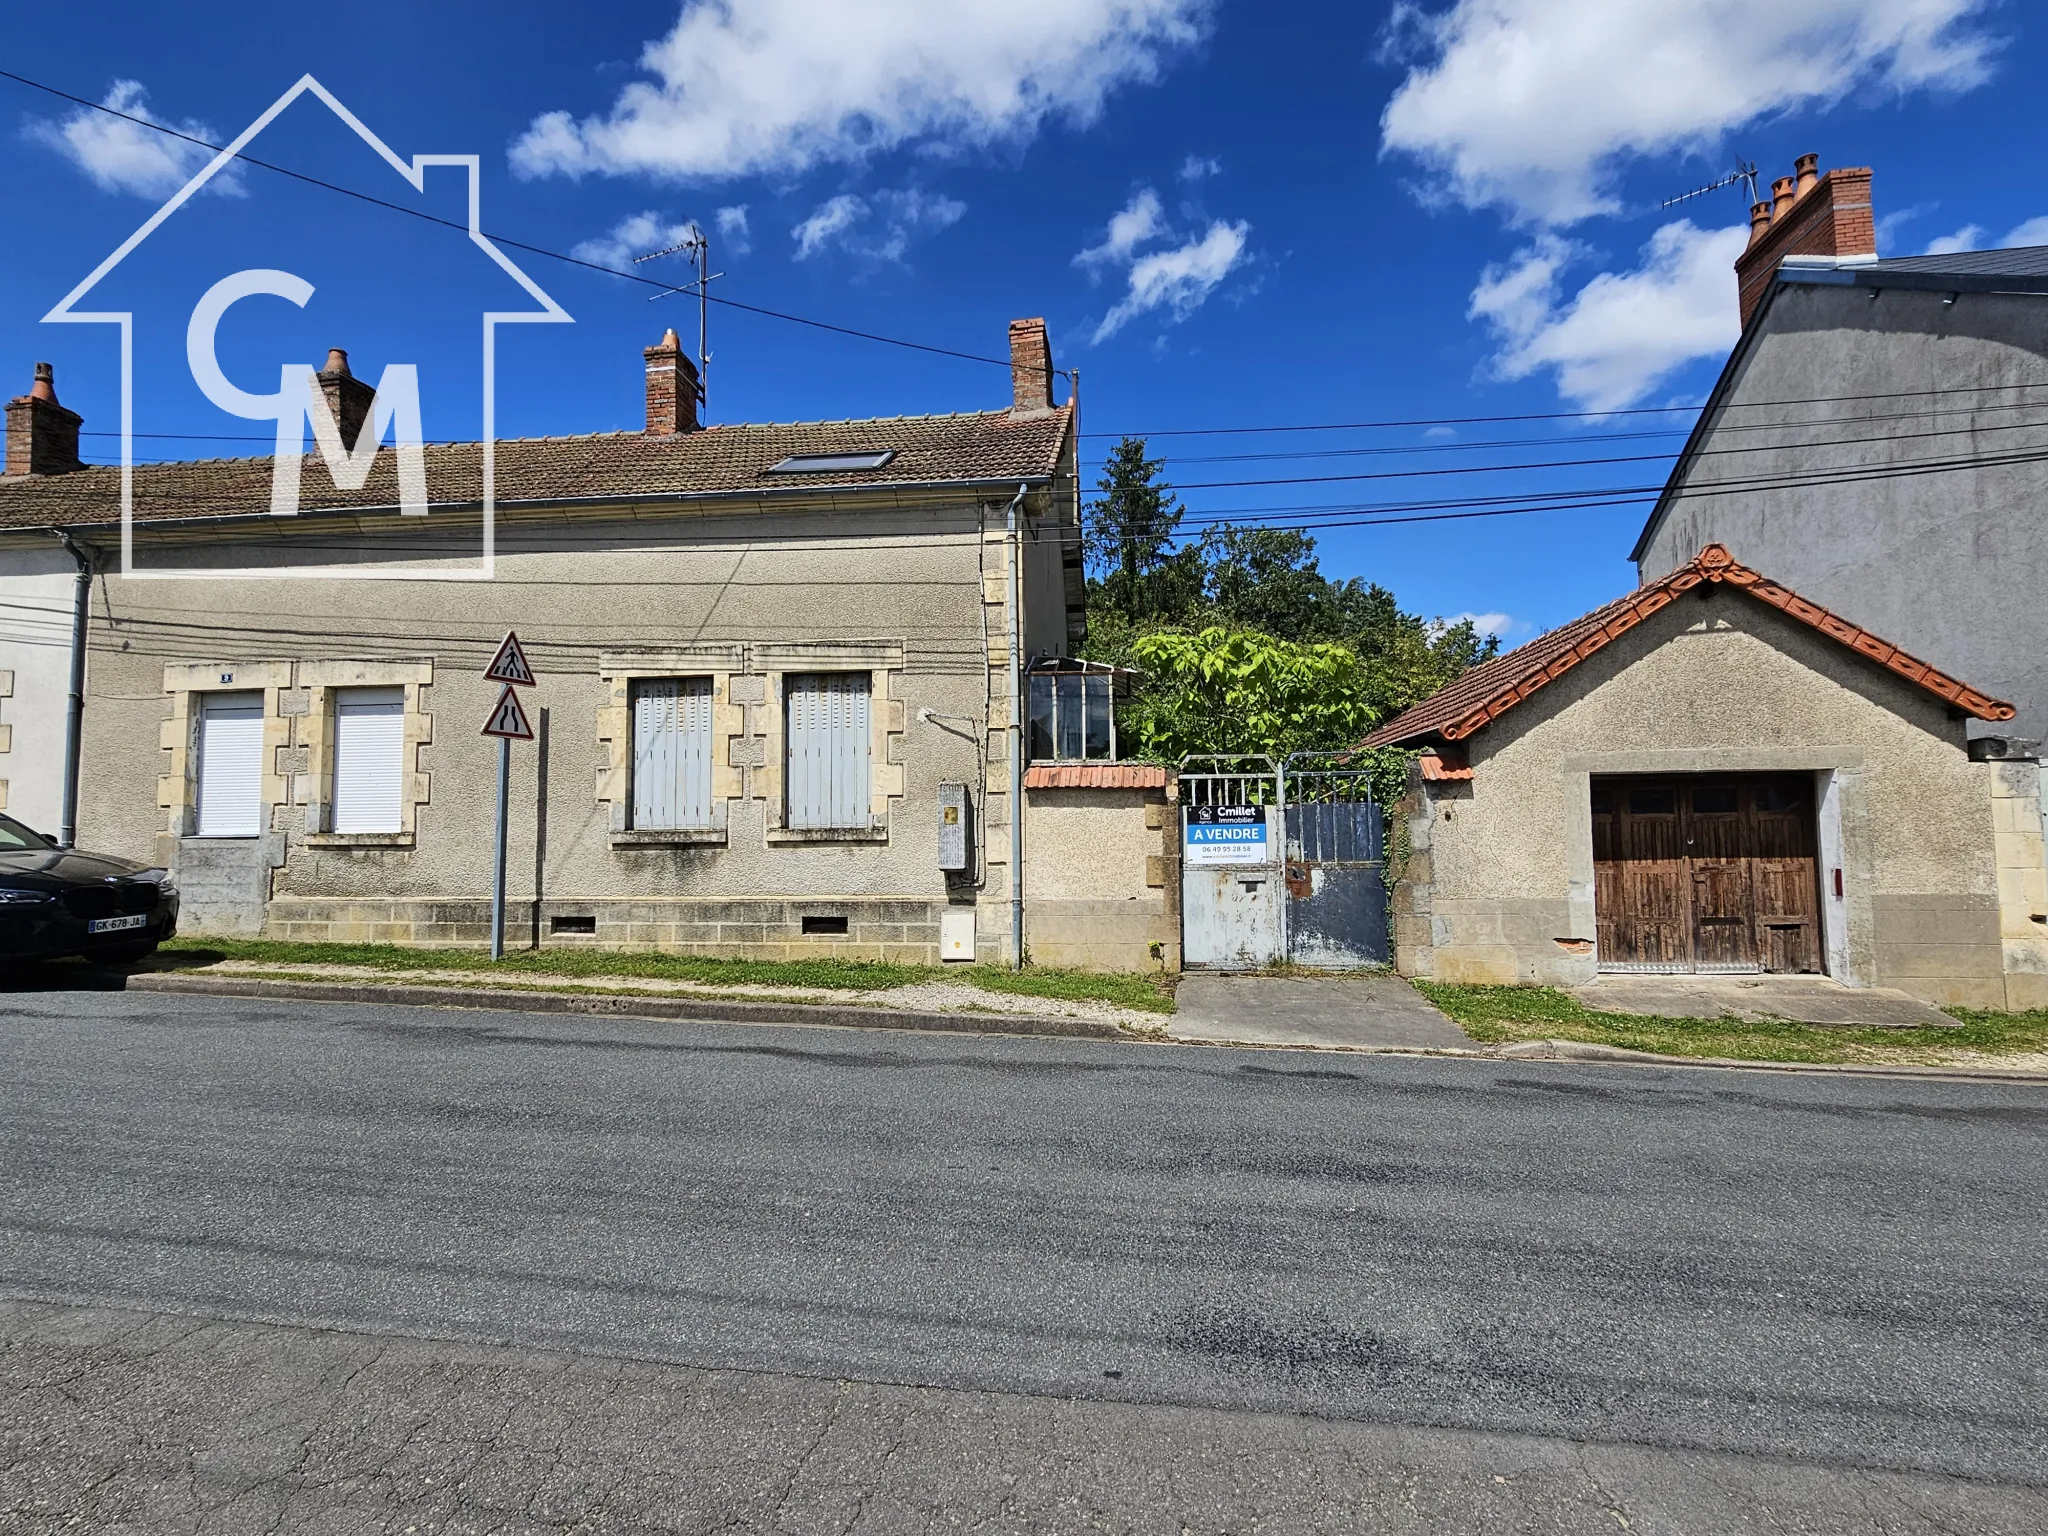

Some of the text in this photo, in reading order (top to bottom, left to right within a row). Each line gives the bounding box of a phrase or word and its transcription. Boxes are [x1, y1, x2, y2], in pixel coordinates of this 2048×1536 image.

[1217, 807, 1256, 816] Cmillet
[1194, 828, 1259, 840] A VENDRE
[96, 917, 140, 931] GK-678-JA
